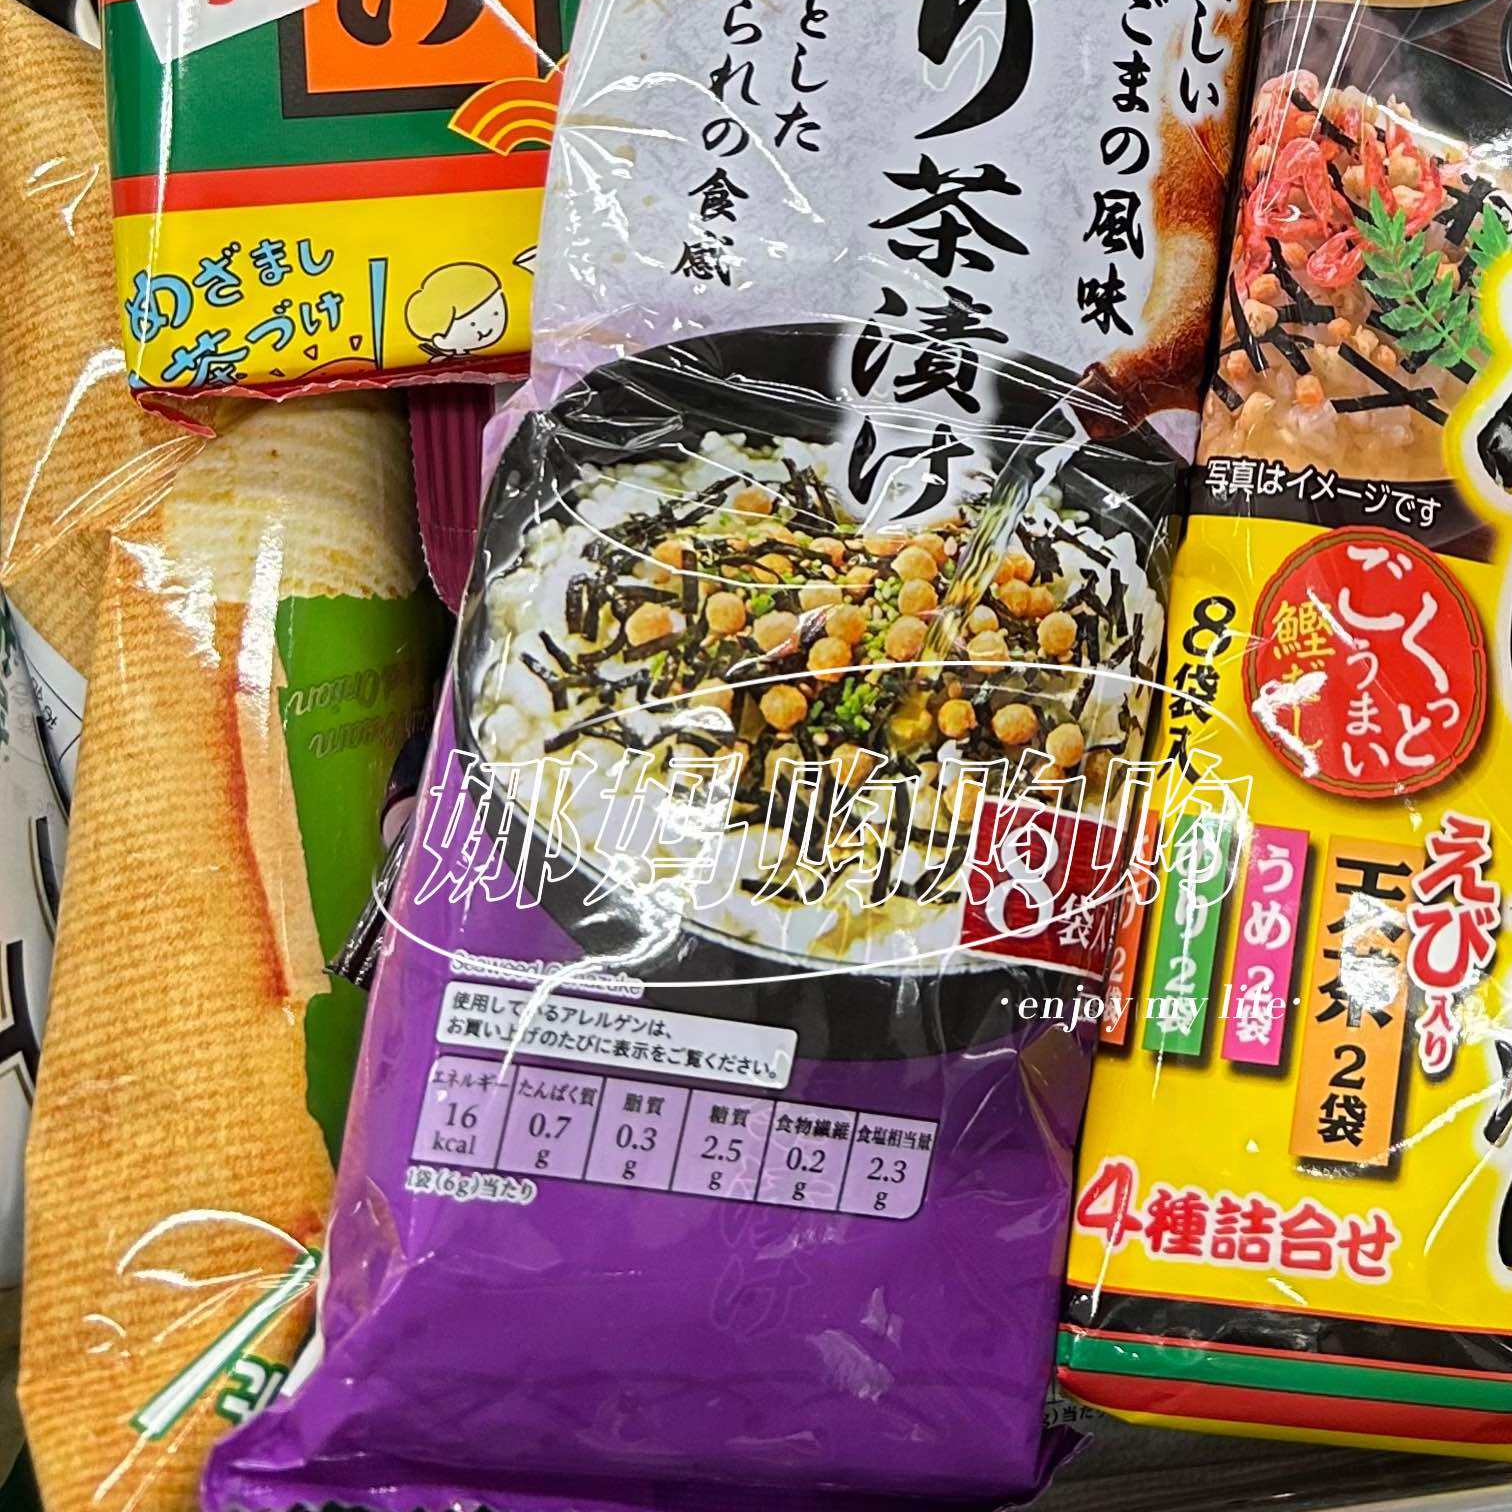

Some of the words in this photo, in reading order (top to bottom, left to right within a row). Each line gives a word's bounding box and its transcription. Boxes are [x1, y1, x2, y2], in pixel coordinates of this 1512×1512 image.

[126, 237, 334, 342] めざまし
[1205, 460, 1442, 528] 写真はイメージです
[518, 1080, 597, 1108] たんぱく質
[623, 1094, 665, 1117] 脂質
[445, 1101, 478, 1129] 16
[528, 1113, 572, 1140] 0.7
[709, 1105, 750, 1129] 糖質
[432, 1134, 476, 1156] kcal
[616, 1124, 658, 1152] 0.3
[701, 1135, 744, 1164] 2.5
[534, 1149, 551, 1169] g
[622, 1160, 638, 1180] g
[785, 1146, 826, 1174] 0.2
[866, 1156, 908, 1183] 2.3
[708, 1170, 724, 1190] g
[792, 1180, 807, 1201] g
[873, 1190, 889, 1211] g
[1077, 1163, 1395, 1277] 4種詰合せ
